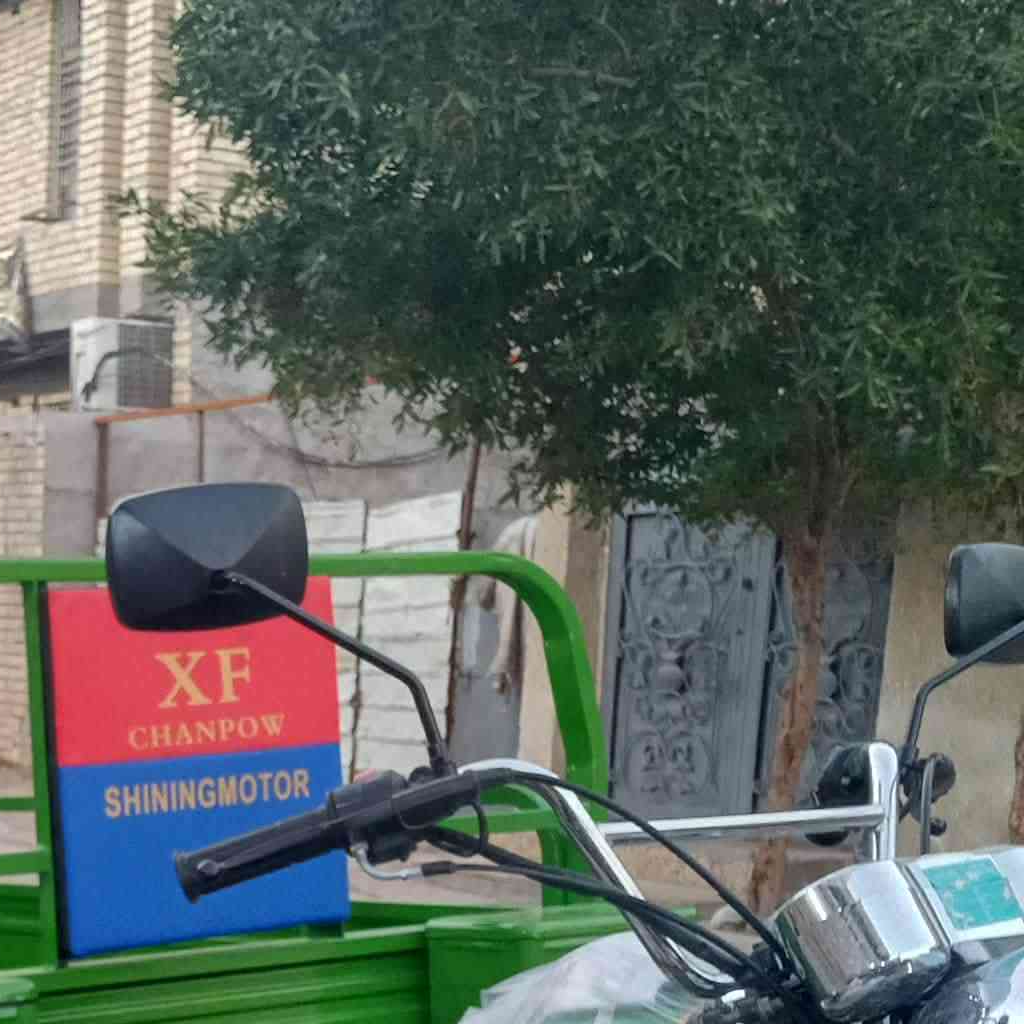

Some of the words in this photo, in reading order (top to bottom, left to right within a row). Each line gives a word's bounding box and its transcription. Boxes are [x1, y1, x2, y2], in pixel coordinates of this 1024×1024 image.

[154, 646, 253, 709] XF
[127, 713, 287, 751] CHANPOW
[104, 768, 311, 819] SHININGMOTOR
